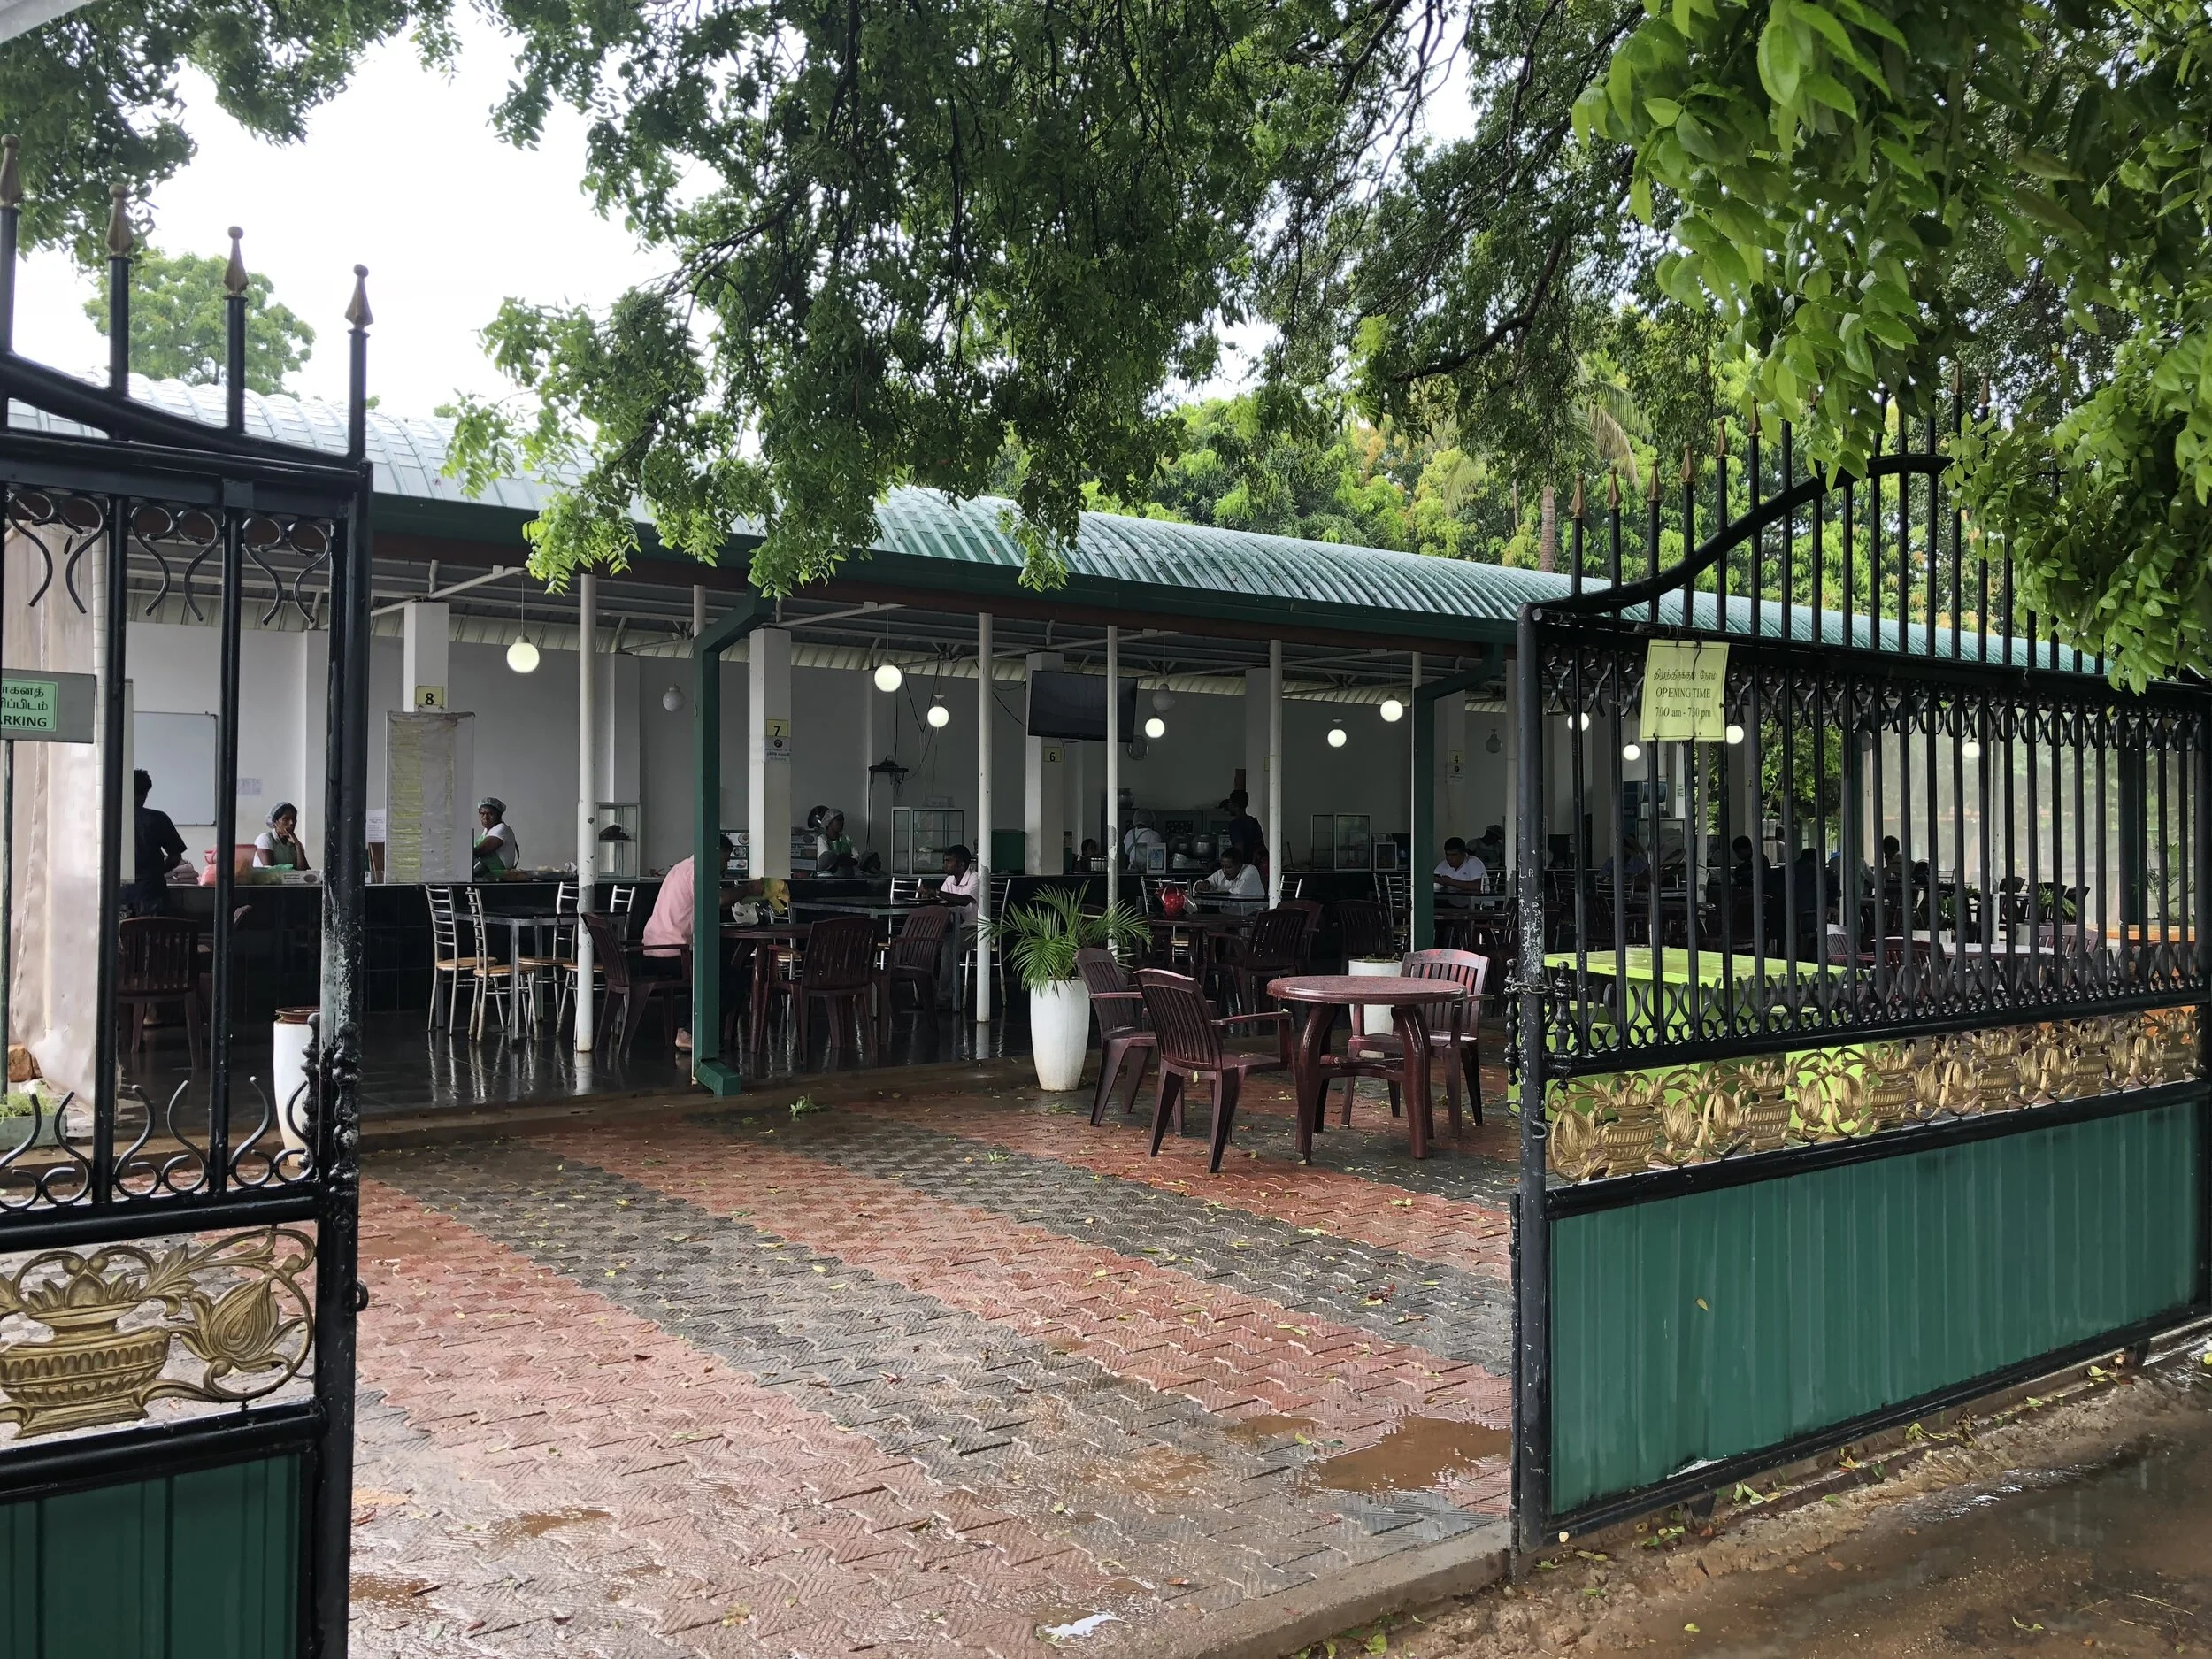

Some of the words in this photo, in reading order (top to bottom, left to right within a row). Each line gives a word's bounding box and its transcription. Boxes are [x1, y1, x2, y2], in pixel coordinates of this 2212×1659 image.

[2, 686, 44, 699] ாகனத்
[1655, 687, 1691, 698] OPENING
[1692, 687, 1711, 699] TIME
[425, 692, 434, 705] 8
[1671, 709, 1682, 718] am
[1701, 710, 1711, 720] pm
[0, 714, 47, 727] RKING
[773, 726, 780, 737] 7
[1049, 752, 1056, 762] 6
[1454, 755, 1459, 764] 4
